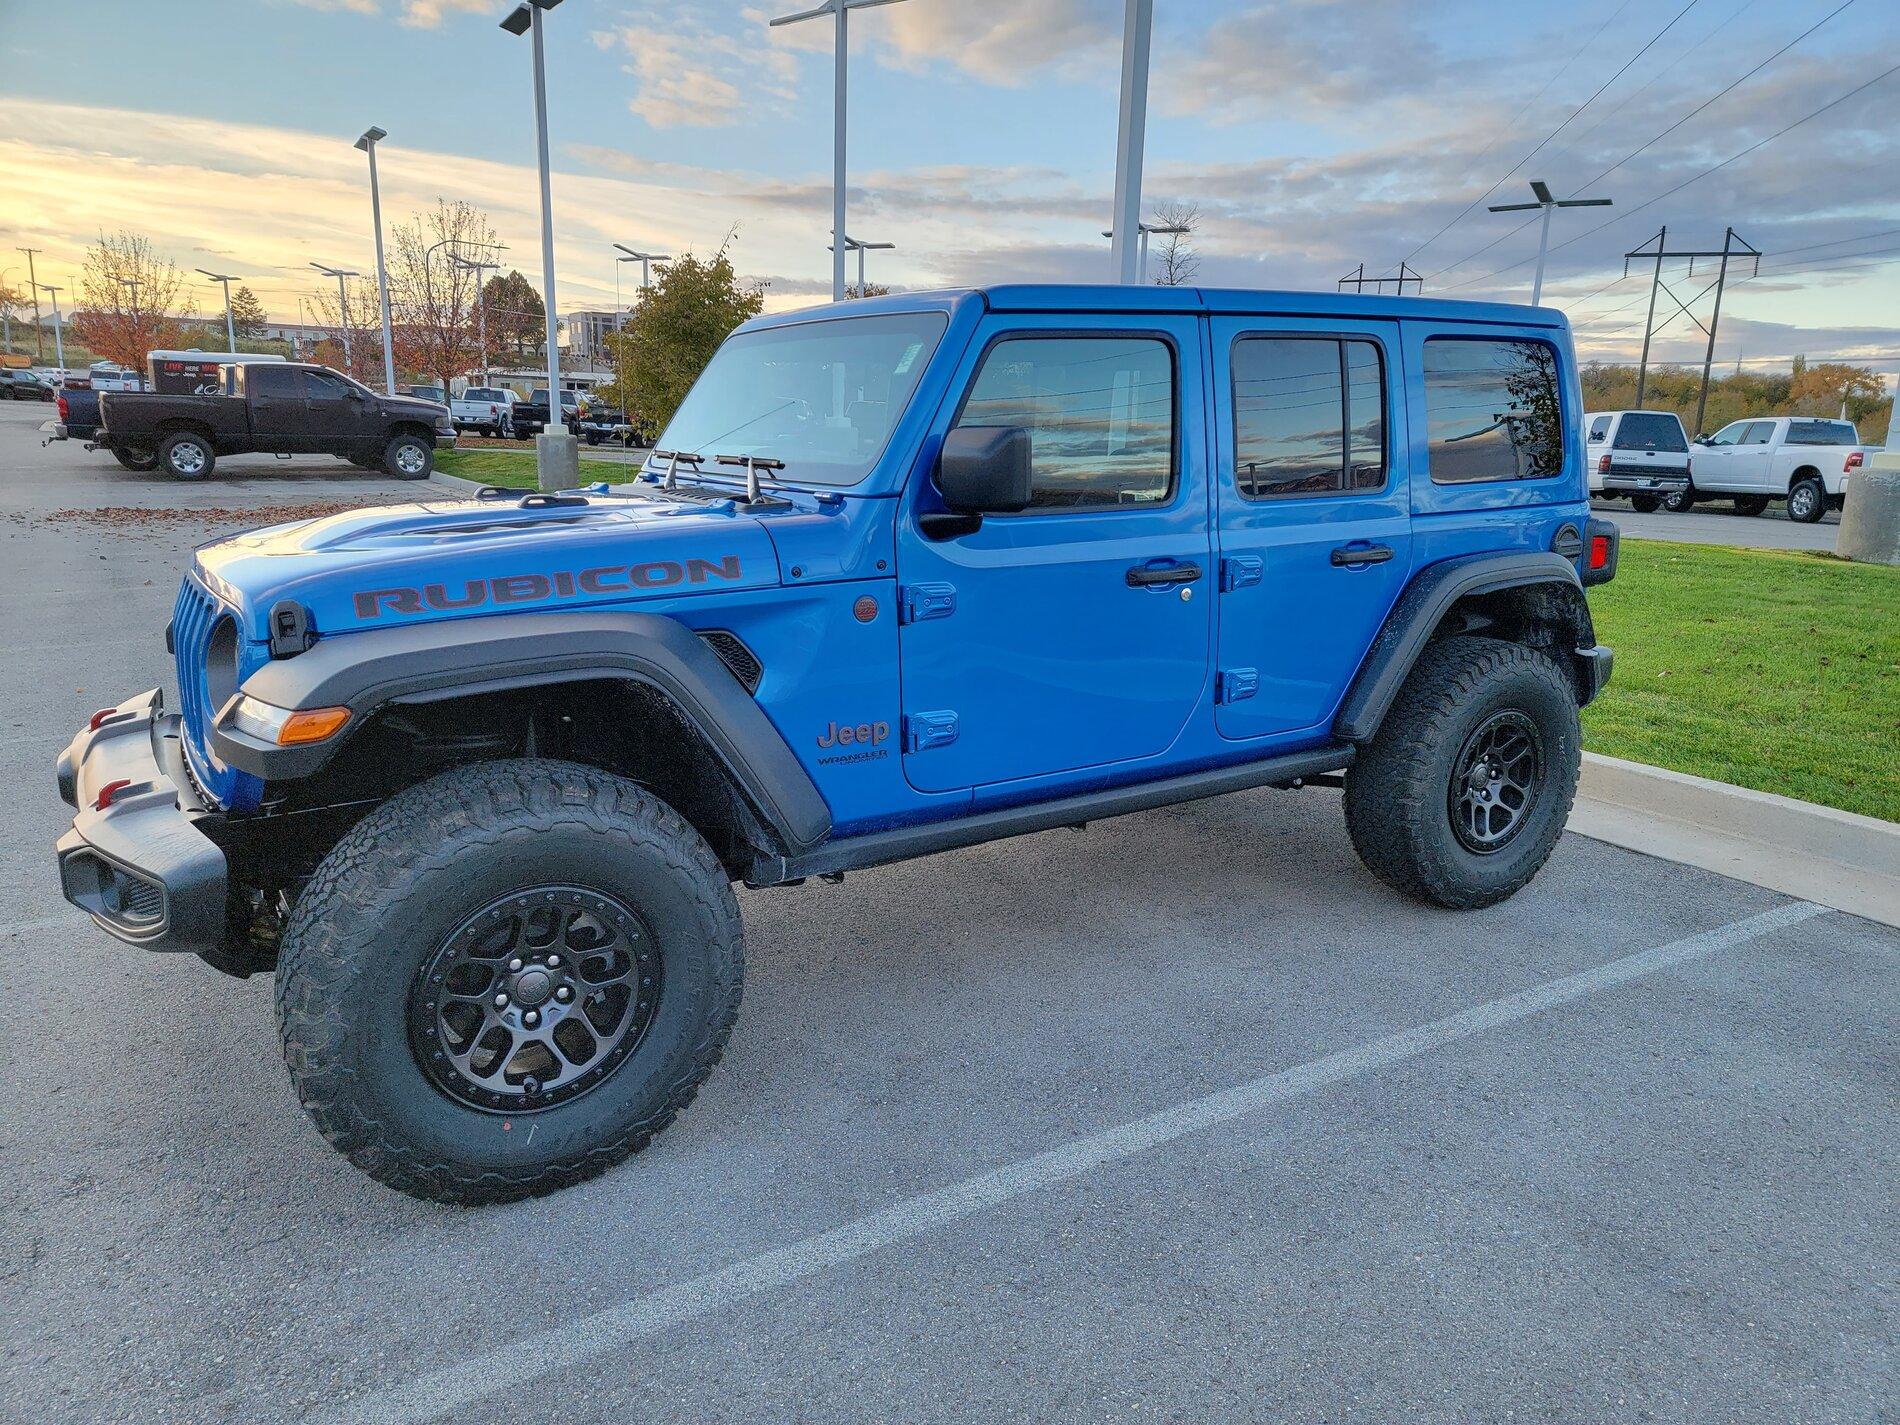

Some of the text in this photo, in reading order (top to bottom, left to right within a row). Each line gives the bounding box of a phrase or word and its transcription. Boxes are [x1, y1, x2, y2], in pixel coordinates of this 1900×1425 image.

[164, 362, 183, 371] LIVE
[353, 555, 743, 619] RUBICON
[816, 721, 890, 748] Jeep
[817, 749, 888, 766] WRANGLER
